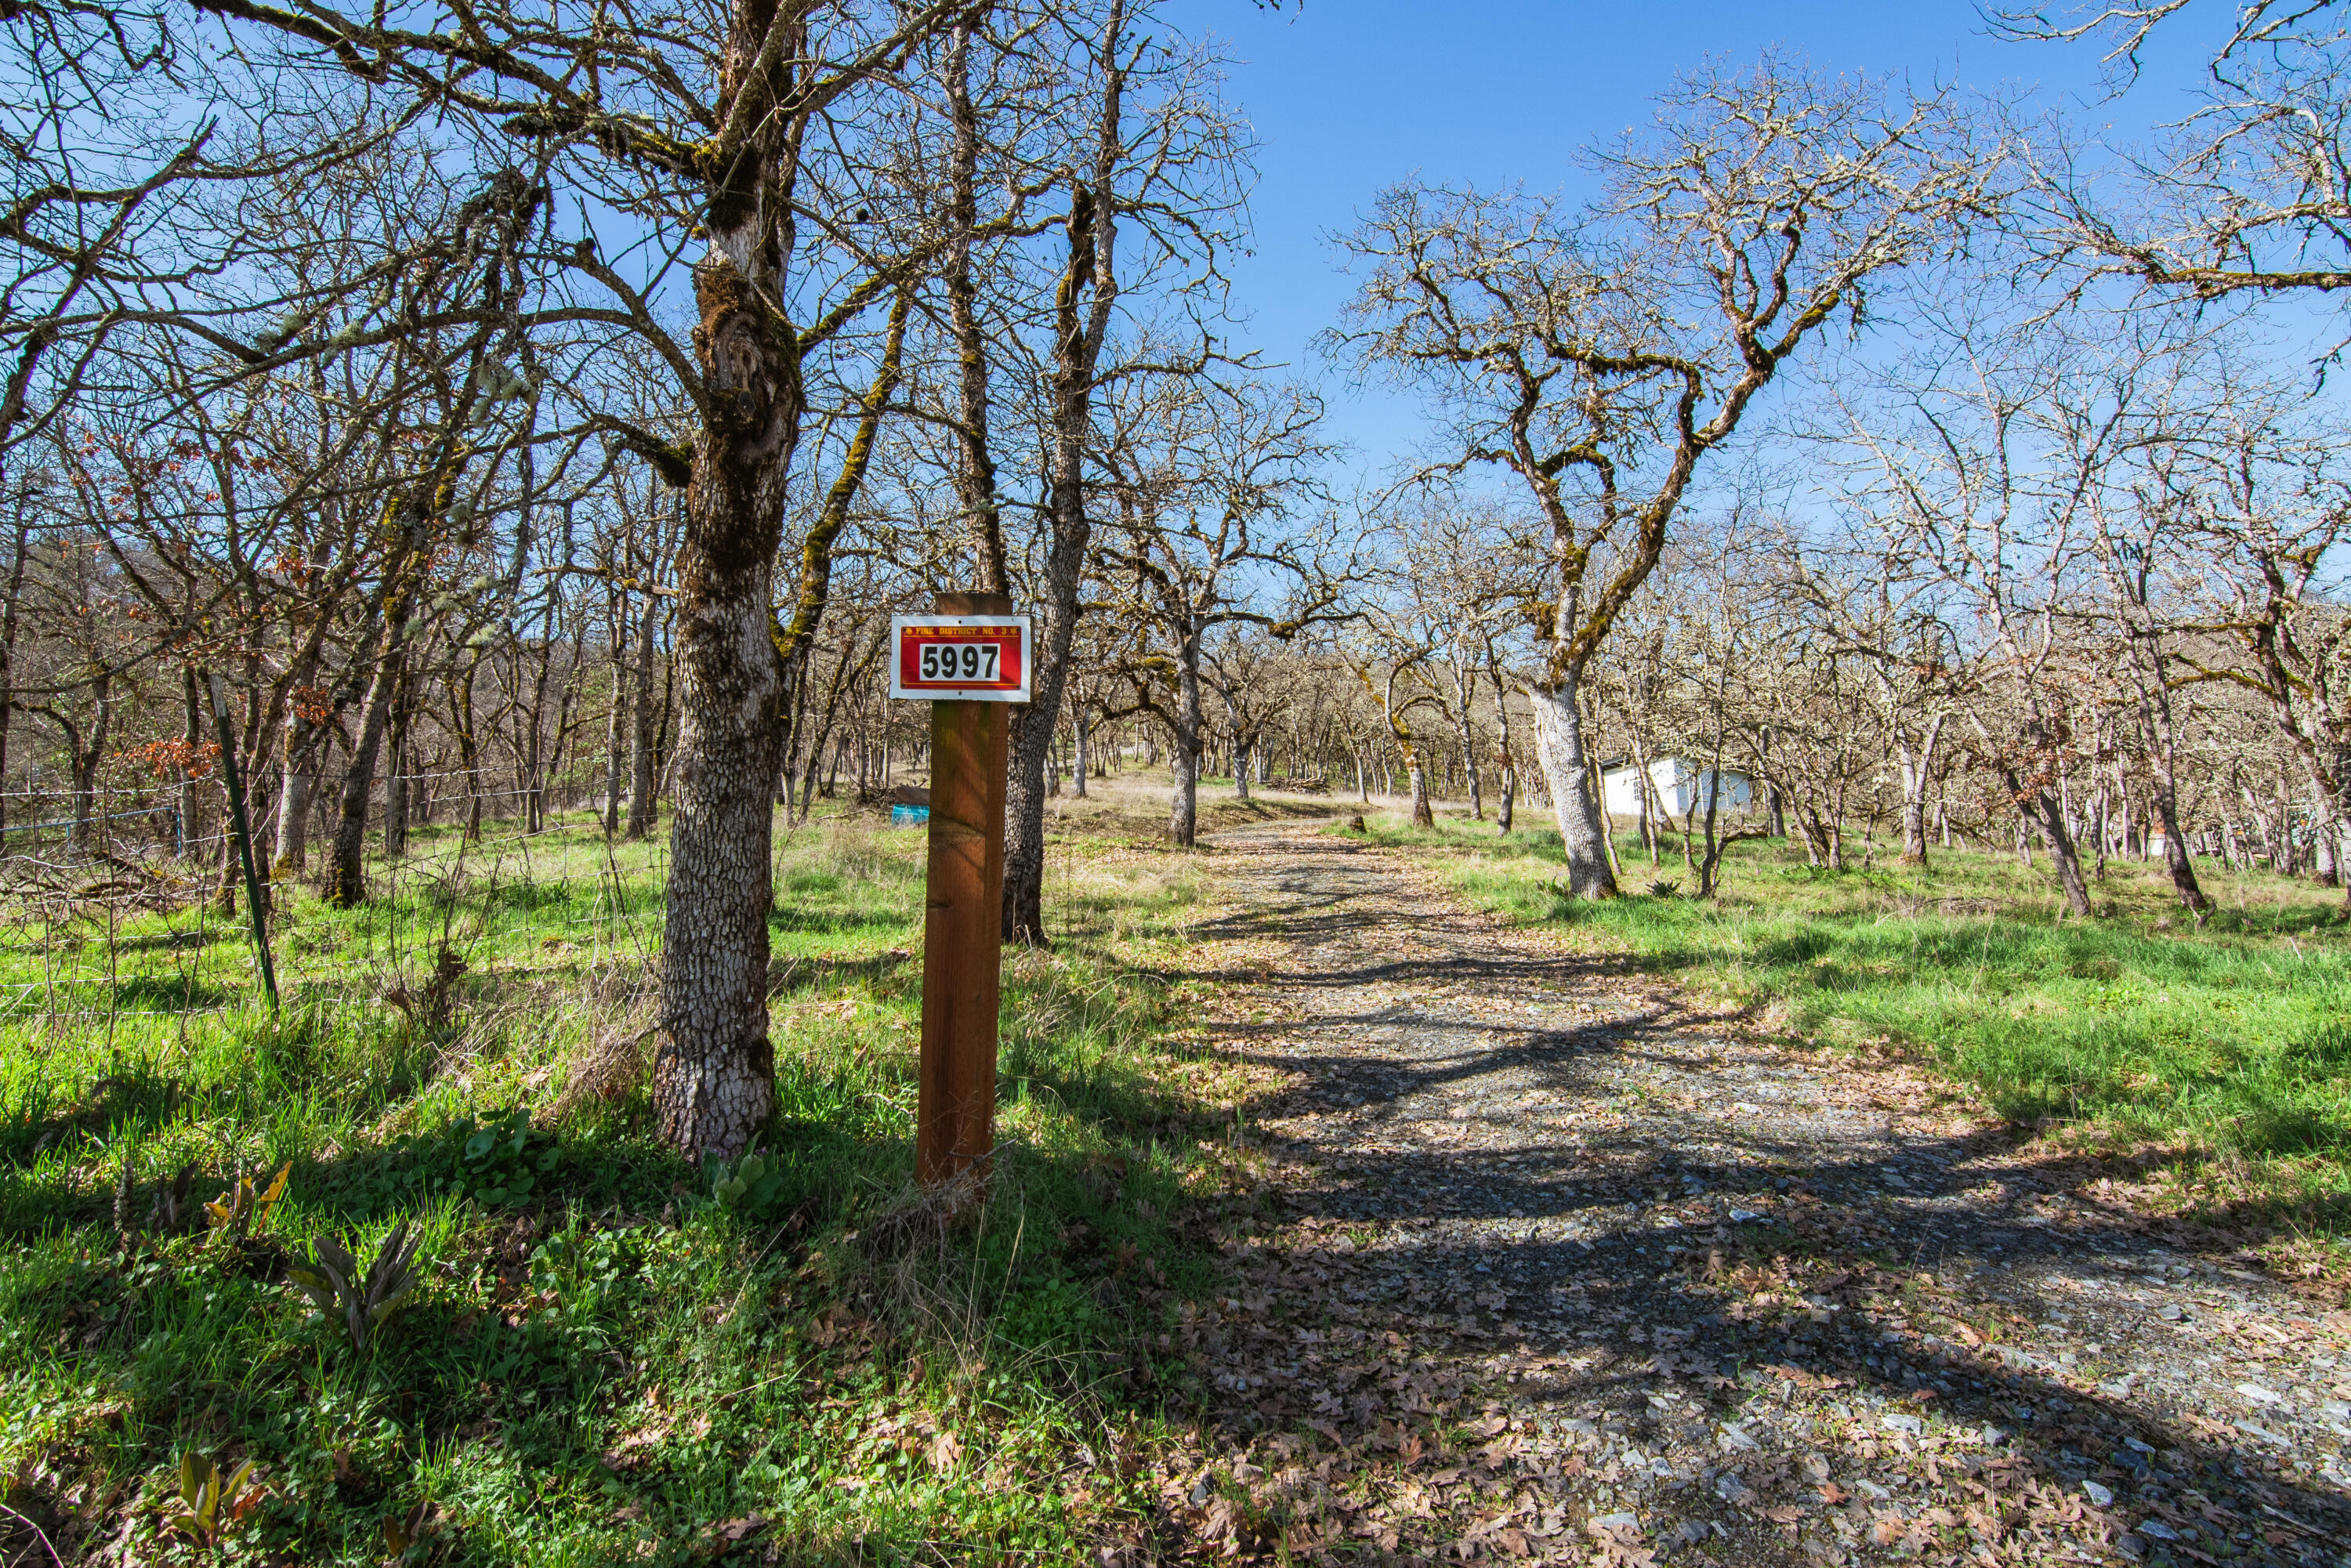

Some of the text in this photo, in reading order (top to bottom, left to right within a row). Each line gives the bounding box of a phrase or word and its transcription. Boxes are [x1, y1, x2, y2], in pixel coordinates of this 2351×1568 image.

[915, 627, 1007, 636] FIRE DISTRICT NO. 3
[922, 645, 998, 679] 5997
